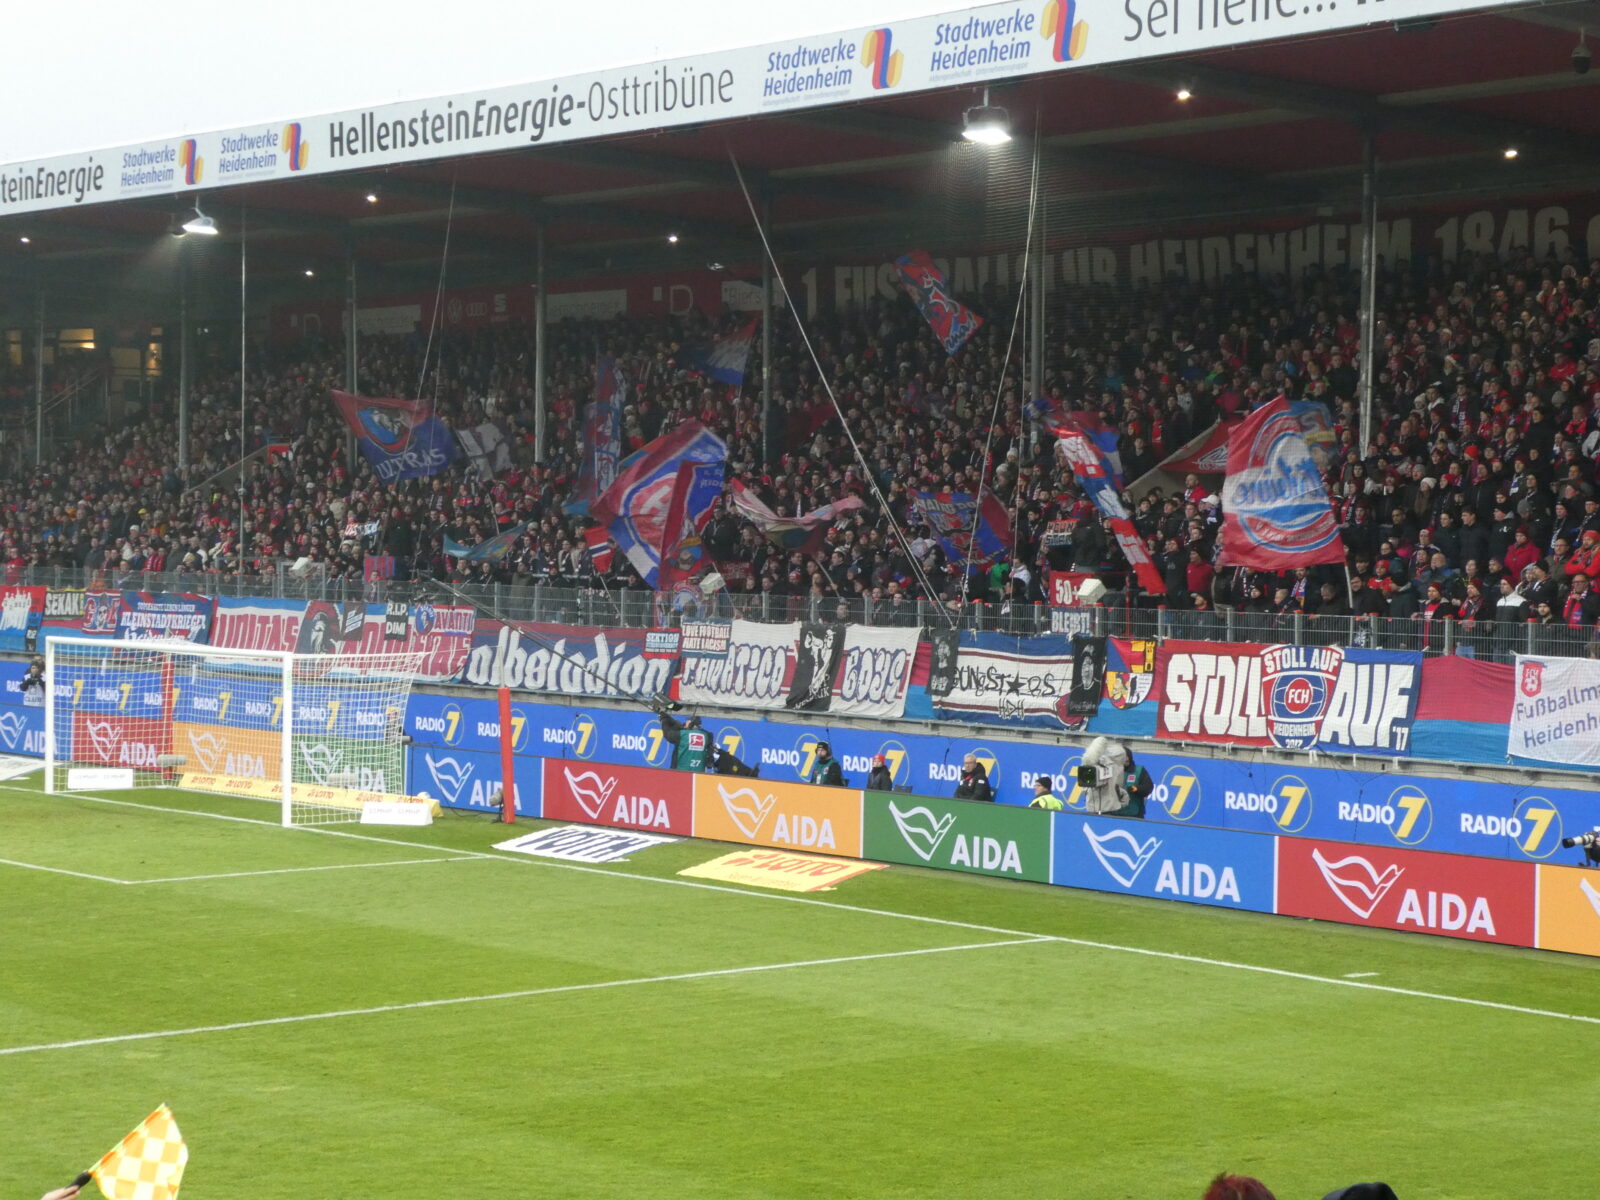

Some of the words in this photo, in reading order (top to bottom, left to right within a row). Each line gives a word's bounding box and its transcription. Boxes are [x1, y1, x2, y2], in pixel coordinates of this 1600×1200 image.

[941, 8, 1035, 46] Stadtwerke
[767, 38, 856, 73] Stadtwerke
[930, 40, 1031, 72] Heidenheim
[763, 66, 852, 97] Heidenheim
[330, 66, 733, 158] HellensteinEnergie-Osttribüne
[122, 145, 176, 169] Stadtwerke
[221, 129, 279, 155] Stadtwerke
[120, 167, 174, 188] Heidenheim
[218, 151, 277, 174] Heidenheim
[1129, 218, 1412, 292] HEIDENHEIM
[1435, 207, 1572, 264] 1846
[1263, 646, 1308, 675] STOLL
[1309, 647, 1341, 673] AUF
[54, 684, 73, 698] ADIO
[96, 688, 119, 703] RADIO
[119, 684, 132, 710] 7
[144, 692, 162, 706] RADI
[193, 697, 218, 711] RADIO
[218, 692, 232, 720] 7
[1163, 653, 1267, 737] STOLL
[1318, 661, 1415, 748] AUF
[1287, 688, 1310, 705] FCH
[1516, 683, 1600, 722] Fußballm
[245, 701, 271, 716] RADIO
[300, 705, 327, 721] RADIO
[326, 701, 342, 730] 7
[356, 711, 384, 727] RADIO
[415, 716, 445, 733] RADIO
[445, 711, 460, 741] 7
[477, 722, 501, 738] RADI
[543, 728, 577, 746] RADIO
[575, 722, 594, 754] 7
[1523, 712, 1600, 749] Heidenh
[118, 741, 158, 767] AIDA
[612, 734, 647, 751] RADIO
[646, 729, 664, 761] 7
[761, 747, 800, 767] RADIO
[800, 742, 819, 777] 7
[224, 752, 266, 779] AIDA
[689, 759, 702, 768] 27
[842, 755, 873, 773] RADI
[929, 763, 962, 782] RADI
[1021, 771, 1068, 792] RAIO
[1170, 775, 1197, 815] 7
[613, 795, 671, 829] AIDA
[1224, 791, 1278, 814] RADIO
[1278, 786, 1307, 826] 7
[1338, 801, 1396, 826] RADIO
[1396, 796, 1427, 839] 7
[772, 813, 837, 850] AIDA
[1460, 813, 1522, 838] RADIO
[1522, 807, 1556, 852] 7
[950, 834, 1023, 875] AIDA
[1154, 859, 1242, 903] AIDA
[1396, 888, 1497, 936] AIDA
